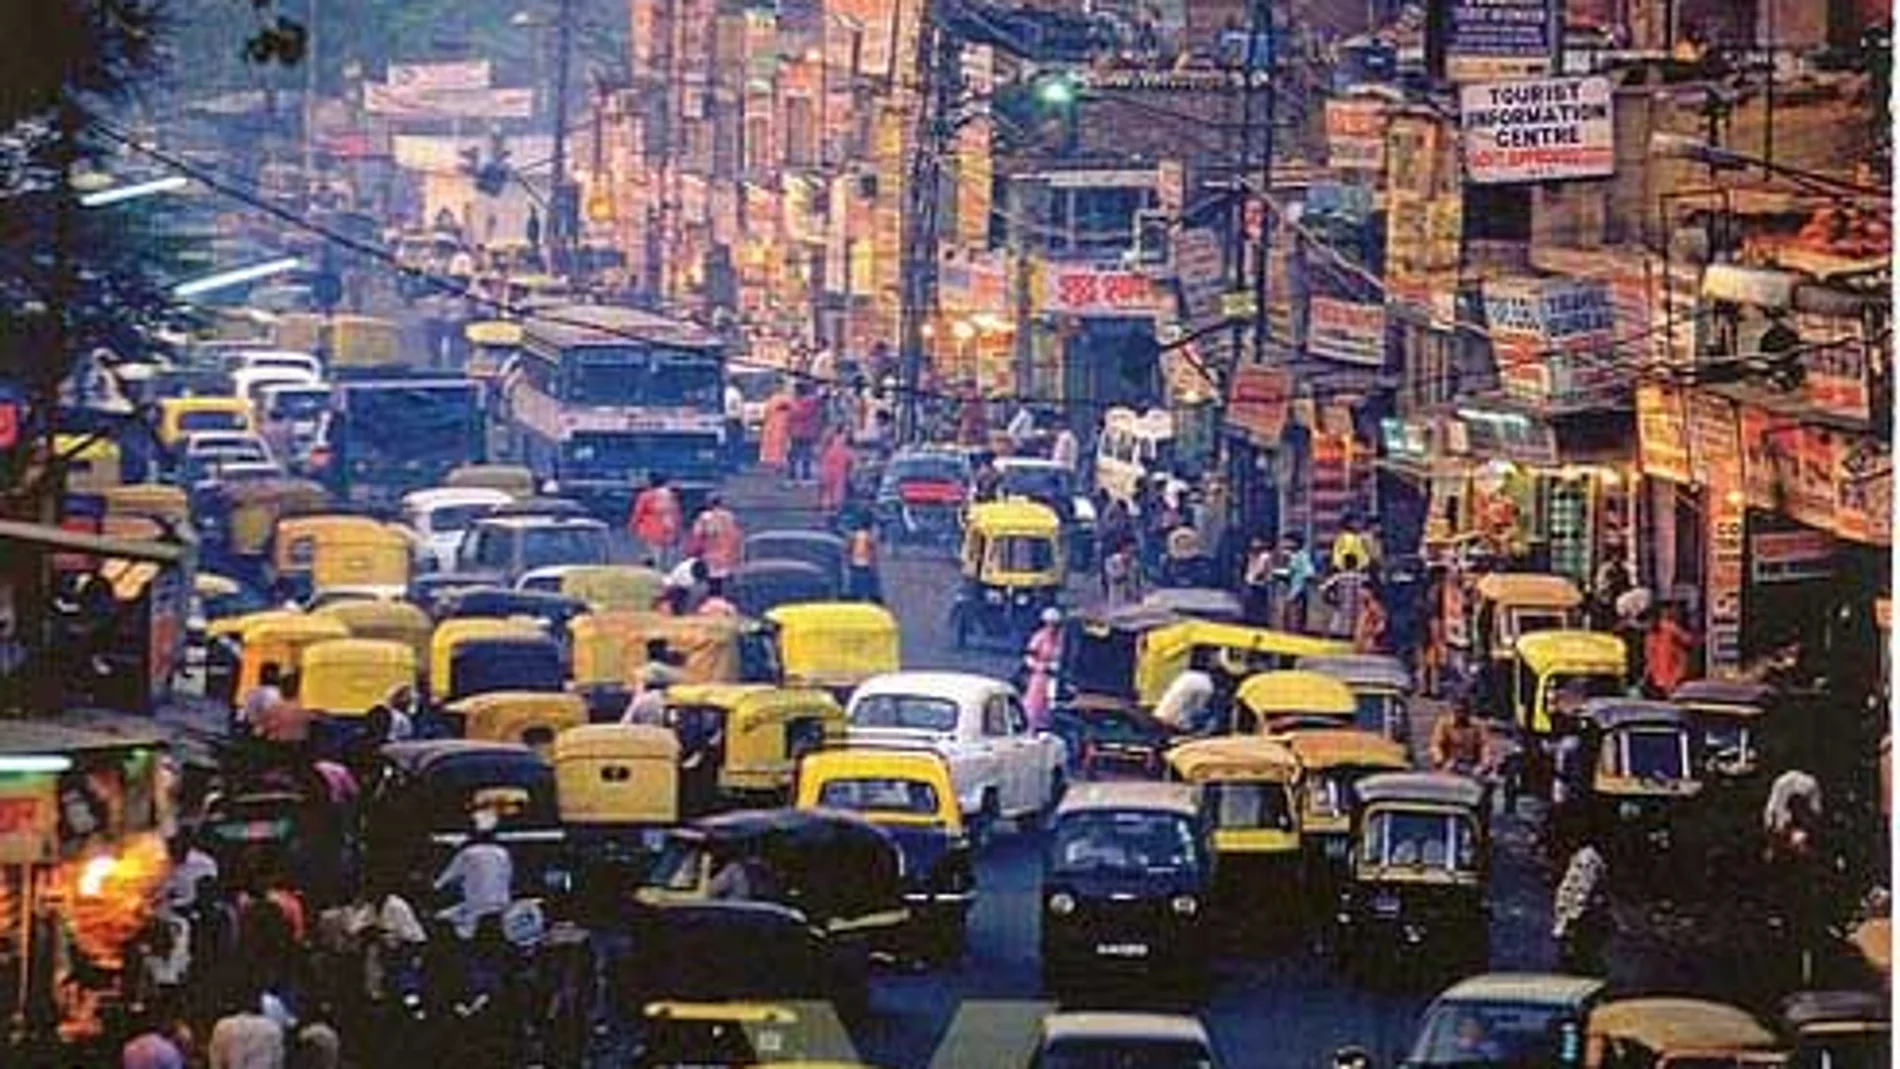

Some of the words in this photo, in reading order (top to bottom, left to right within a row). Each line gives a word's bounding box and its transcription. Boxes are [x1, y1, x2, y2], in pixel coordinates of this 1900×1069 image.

[1488, 83, 1581, 105] TOURIST
[1467, 103, 1607, 127] INFORMATION
[1495, 125, 1583, 148] CENTRE
